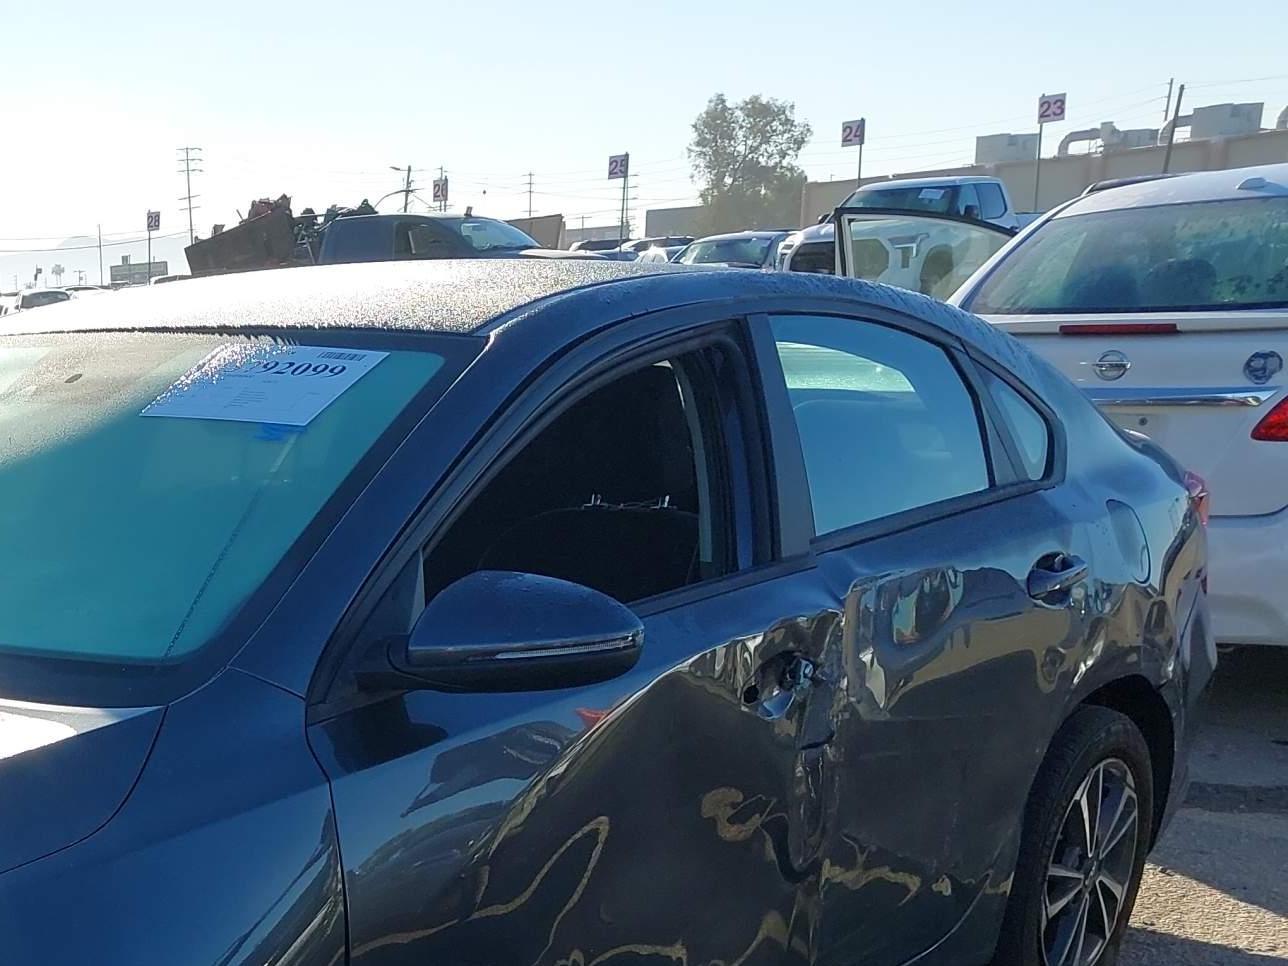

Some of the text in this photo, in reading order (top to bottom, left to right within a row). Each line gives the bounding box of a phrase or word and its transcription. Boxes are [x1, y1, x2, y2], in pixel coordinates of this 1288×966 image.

[1040, 99, 1065, 118] 23
[842, 125, 861, 142] 24
[147, 214, 159, 227] 28
